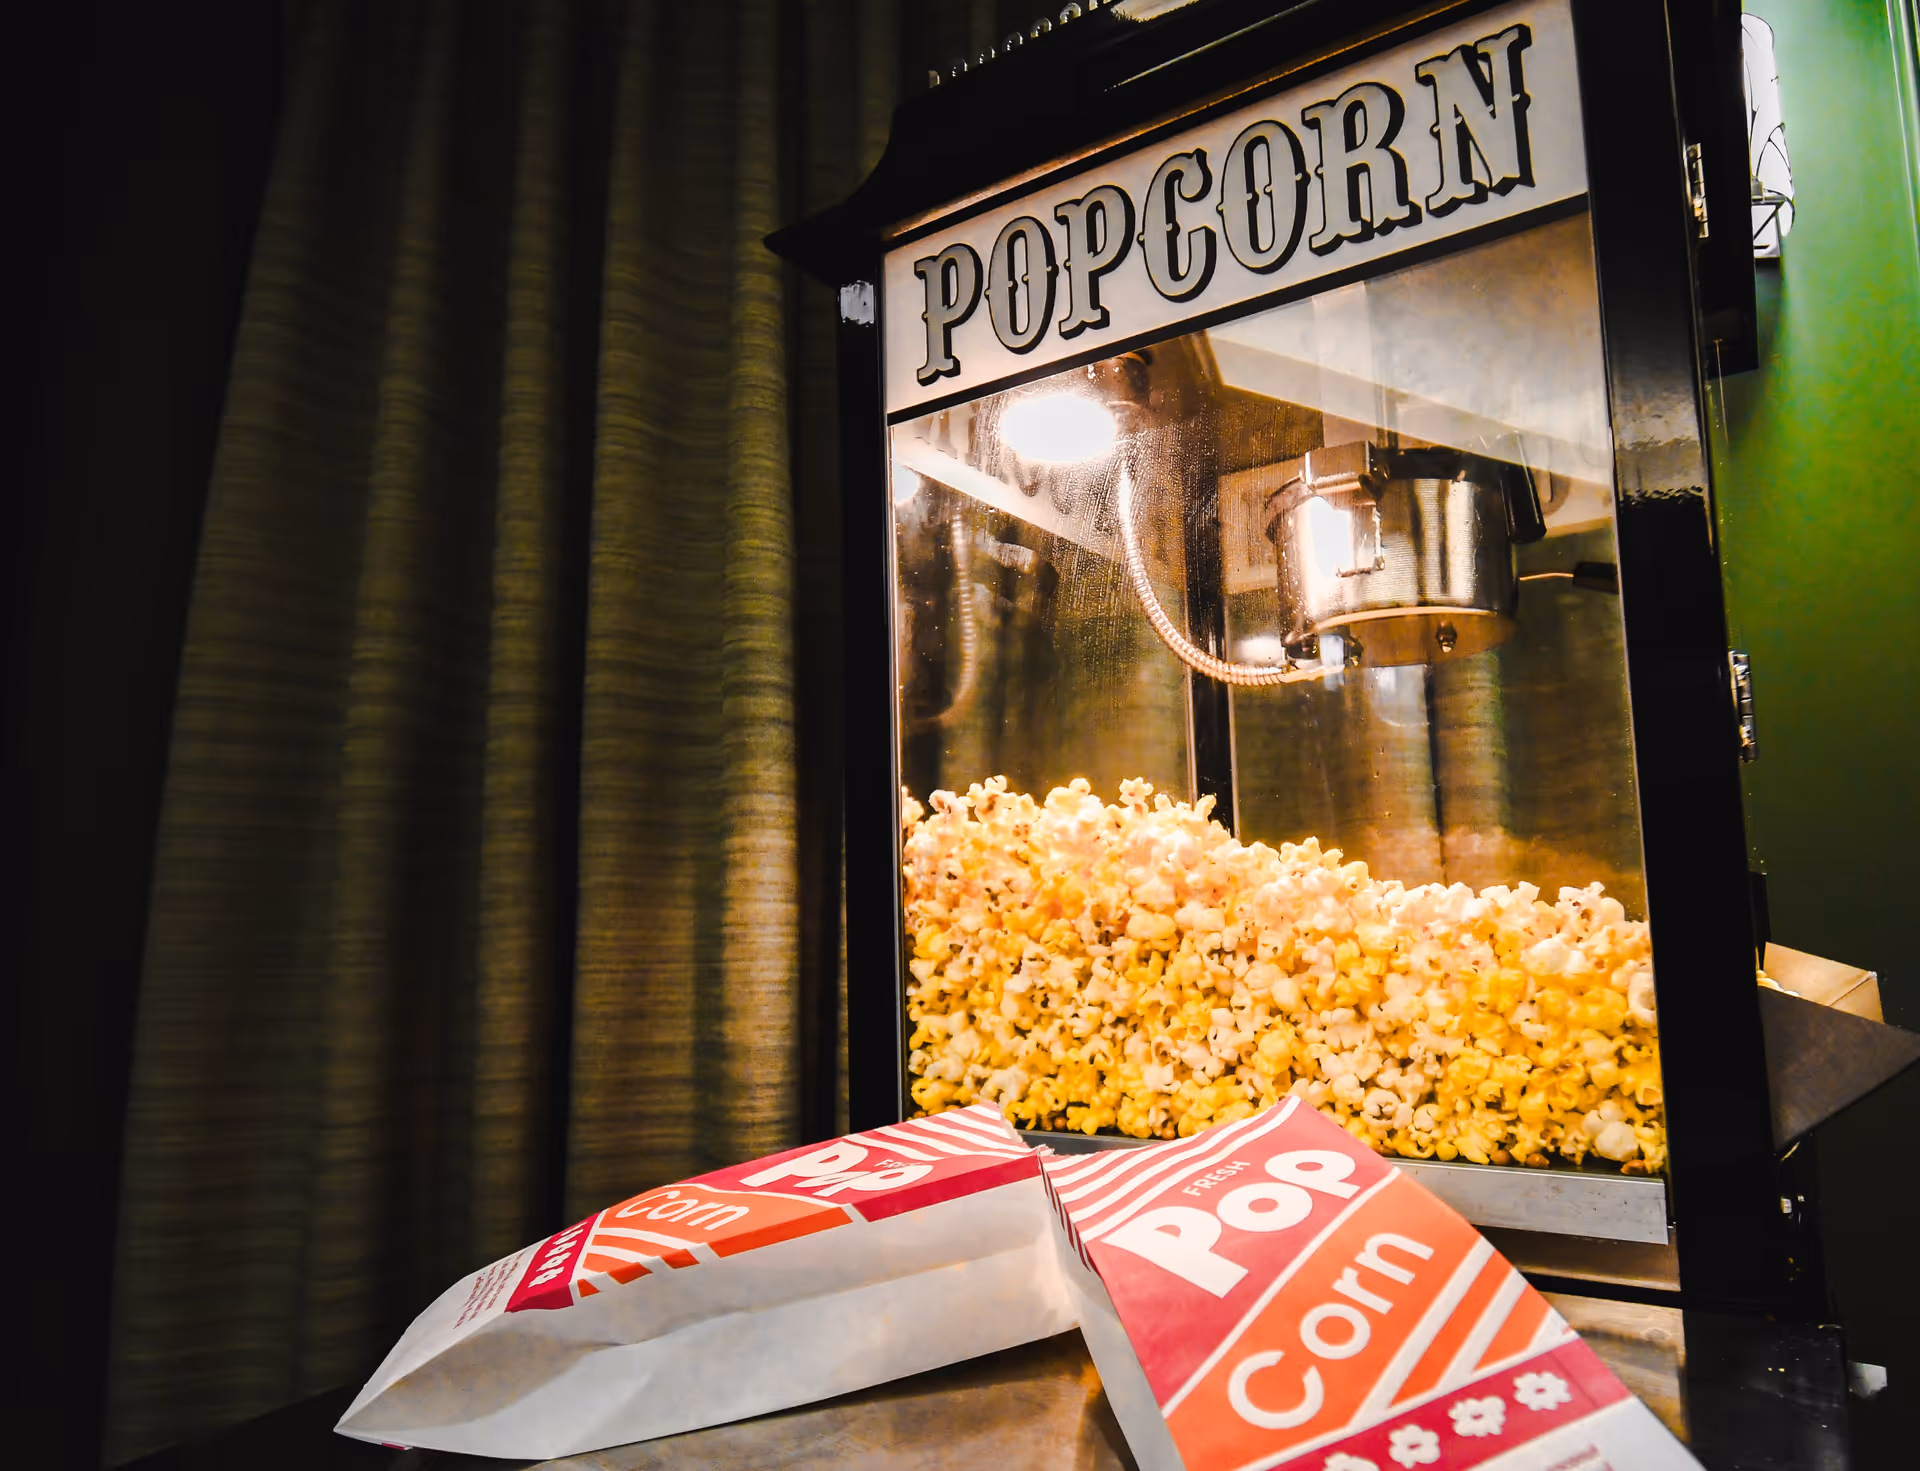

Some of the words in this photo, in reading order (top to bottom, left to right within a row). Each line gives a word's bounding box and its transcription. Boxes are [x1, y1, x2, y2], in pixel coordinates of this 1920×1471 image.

[913, 24, 1535, 387] POPCORN
[615, 1190, 750, 1231] Corn
[1182, 1161, 1251, 1197] FRESH
[1228, 1233, 1435, 1430] Corn
